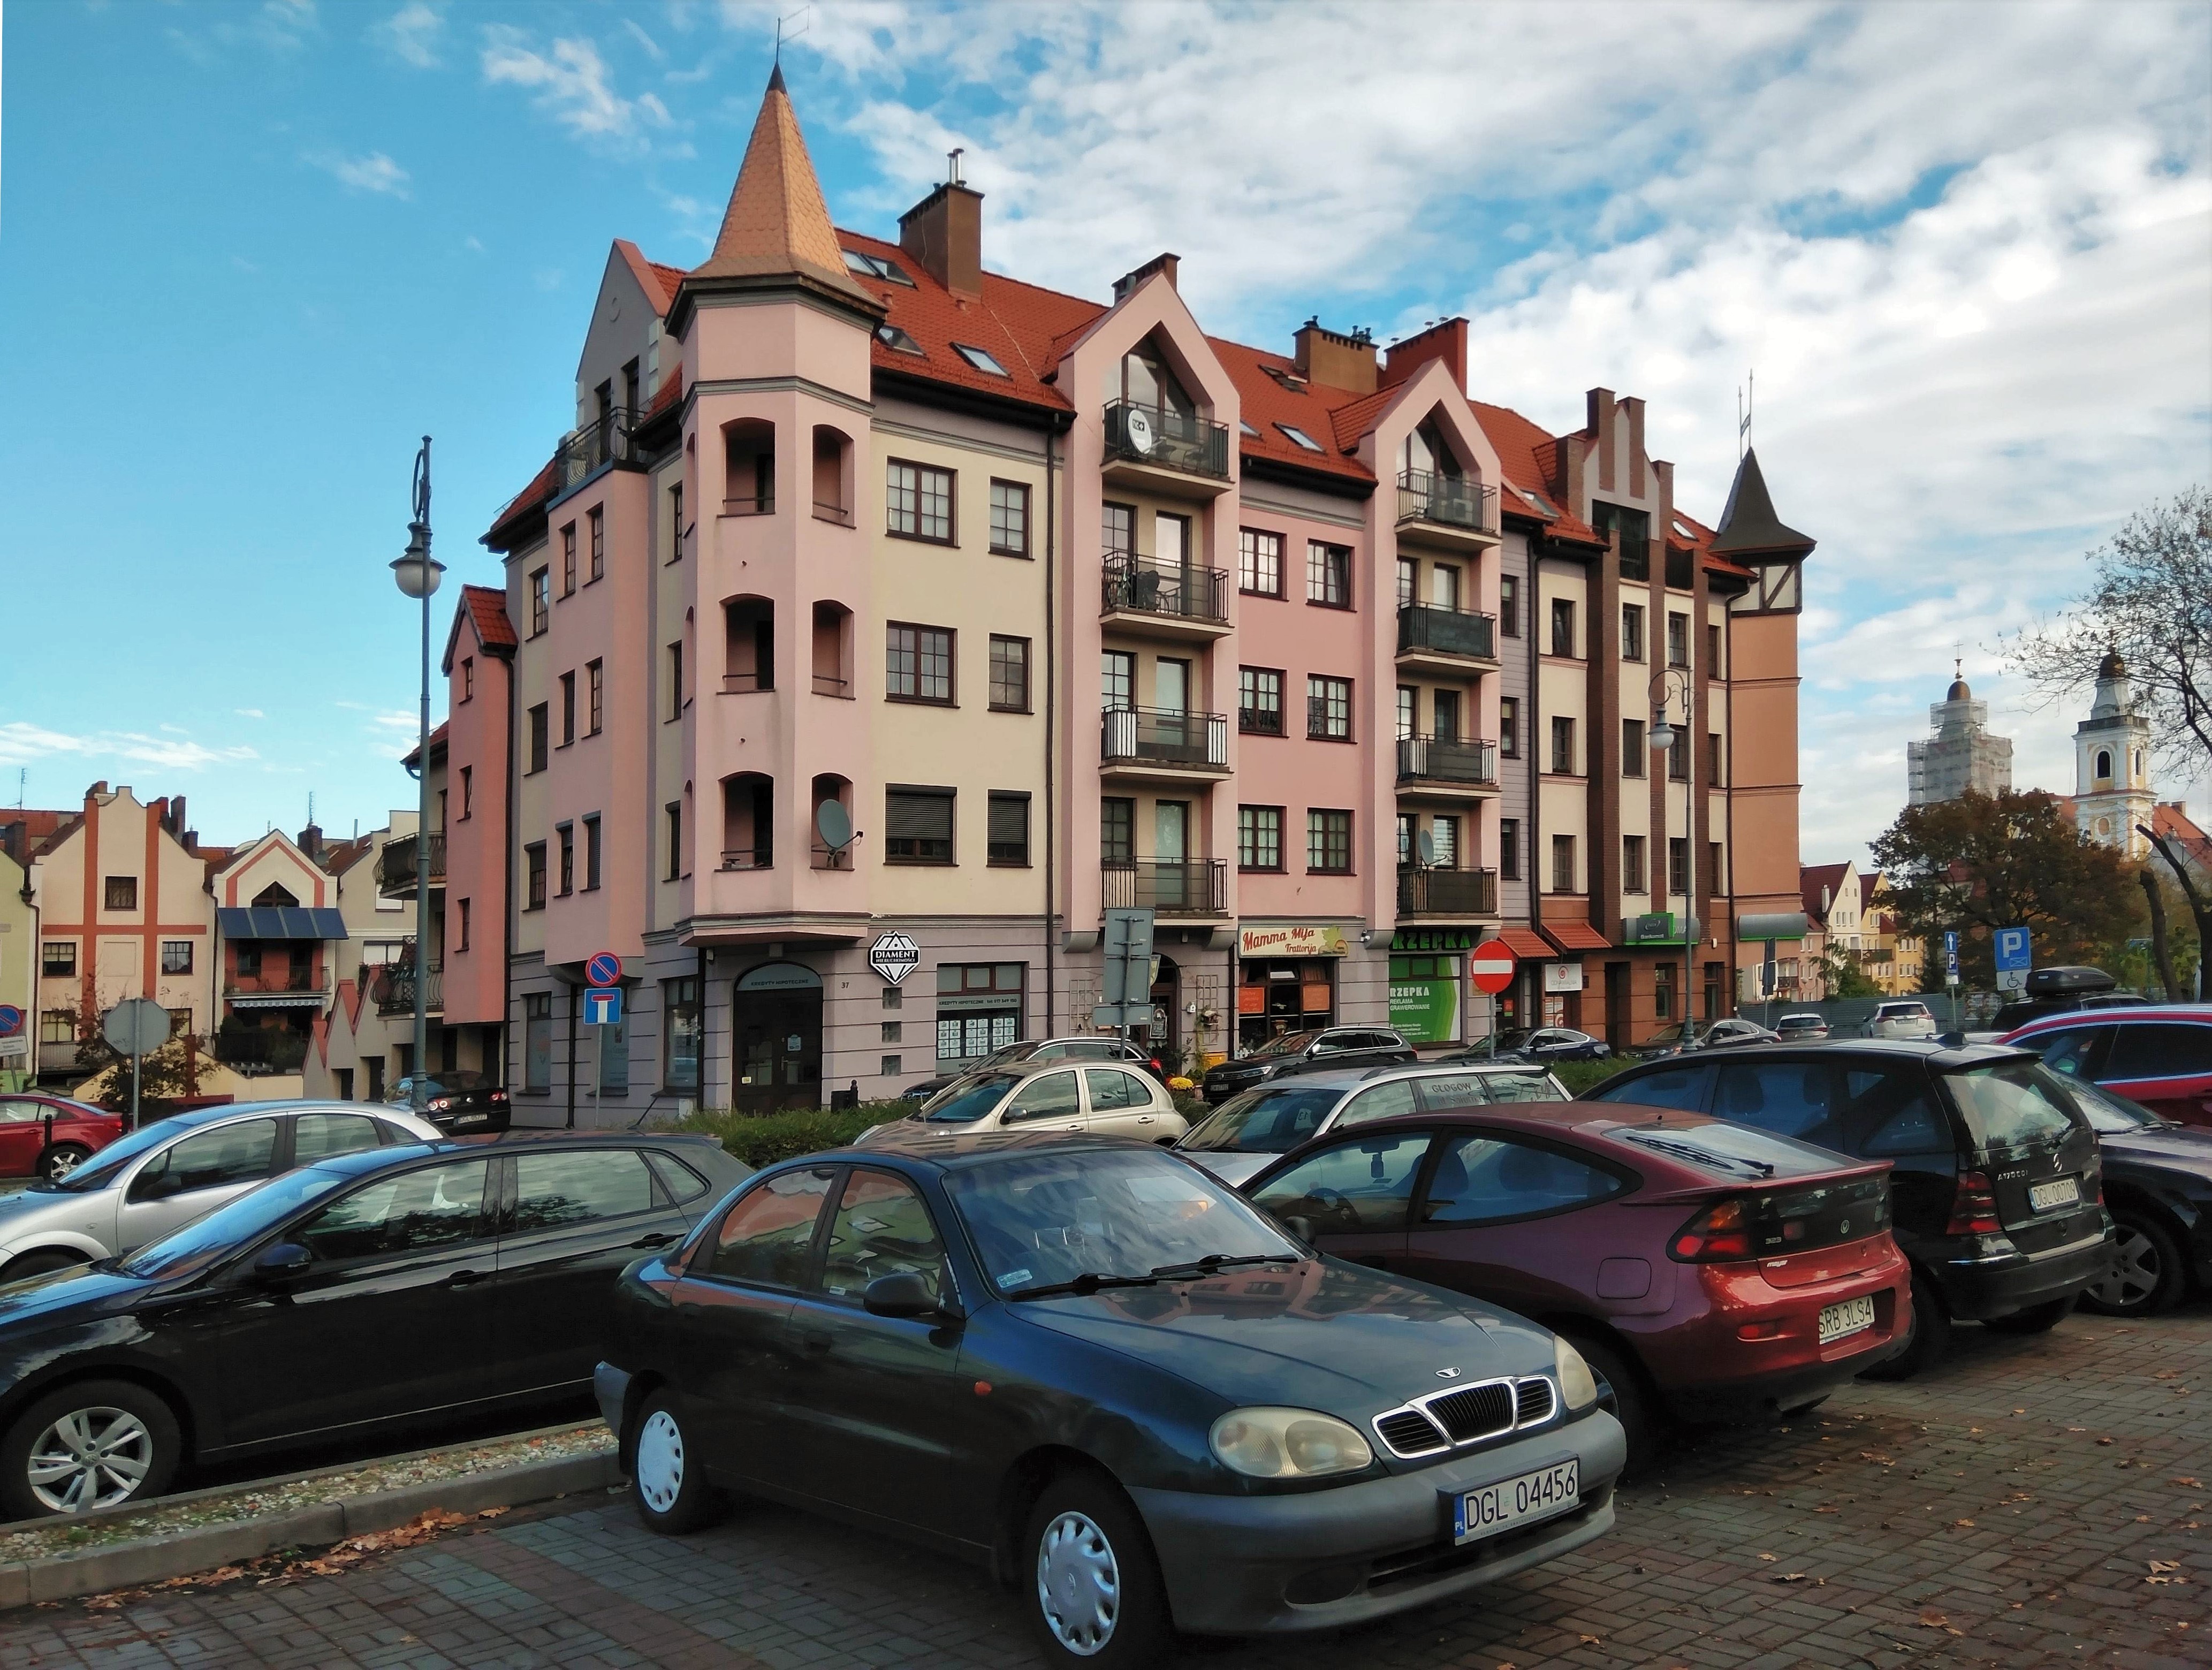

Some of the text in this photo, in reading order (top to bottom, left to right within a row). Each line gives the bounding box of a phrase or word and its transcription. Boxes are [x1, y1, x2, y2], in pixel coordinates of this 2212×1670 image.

[1243, 928, 1315, 952] Mamma Mija
[1393, 932, 1471, 949] RZEPKA
[2002, 932, 2021, 958] P
[1285, 944, 1317, 955] Trattorija
[1949, 954, 1955, 968] P
[1389, 986, 1430, 997] RZEPKA
[2033, 1181, 2076, 1206] DGL 00709
[1765, 1236, 1782, 1244] 323
[1819, 1308, 1841, 1335] SRB
[1466, 1488, 1508, 1530] DGL
[1516, 1464, 1575, 1513] 04456
[1455, 1521, 1464, 1531] PL
